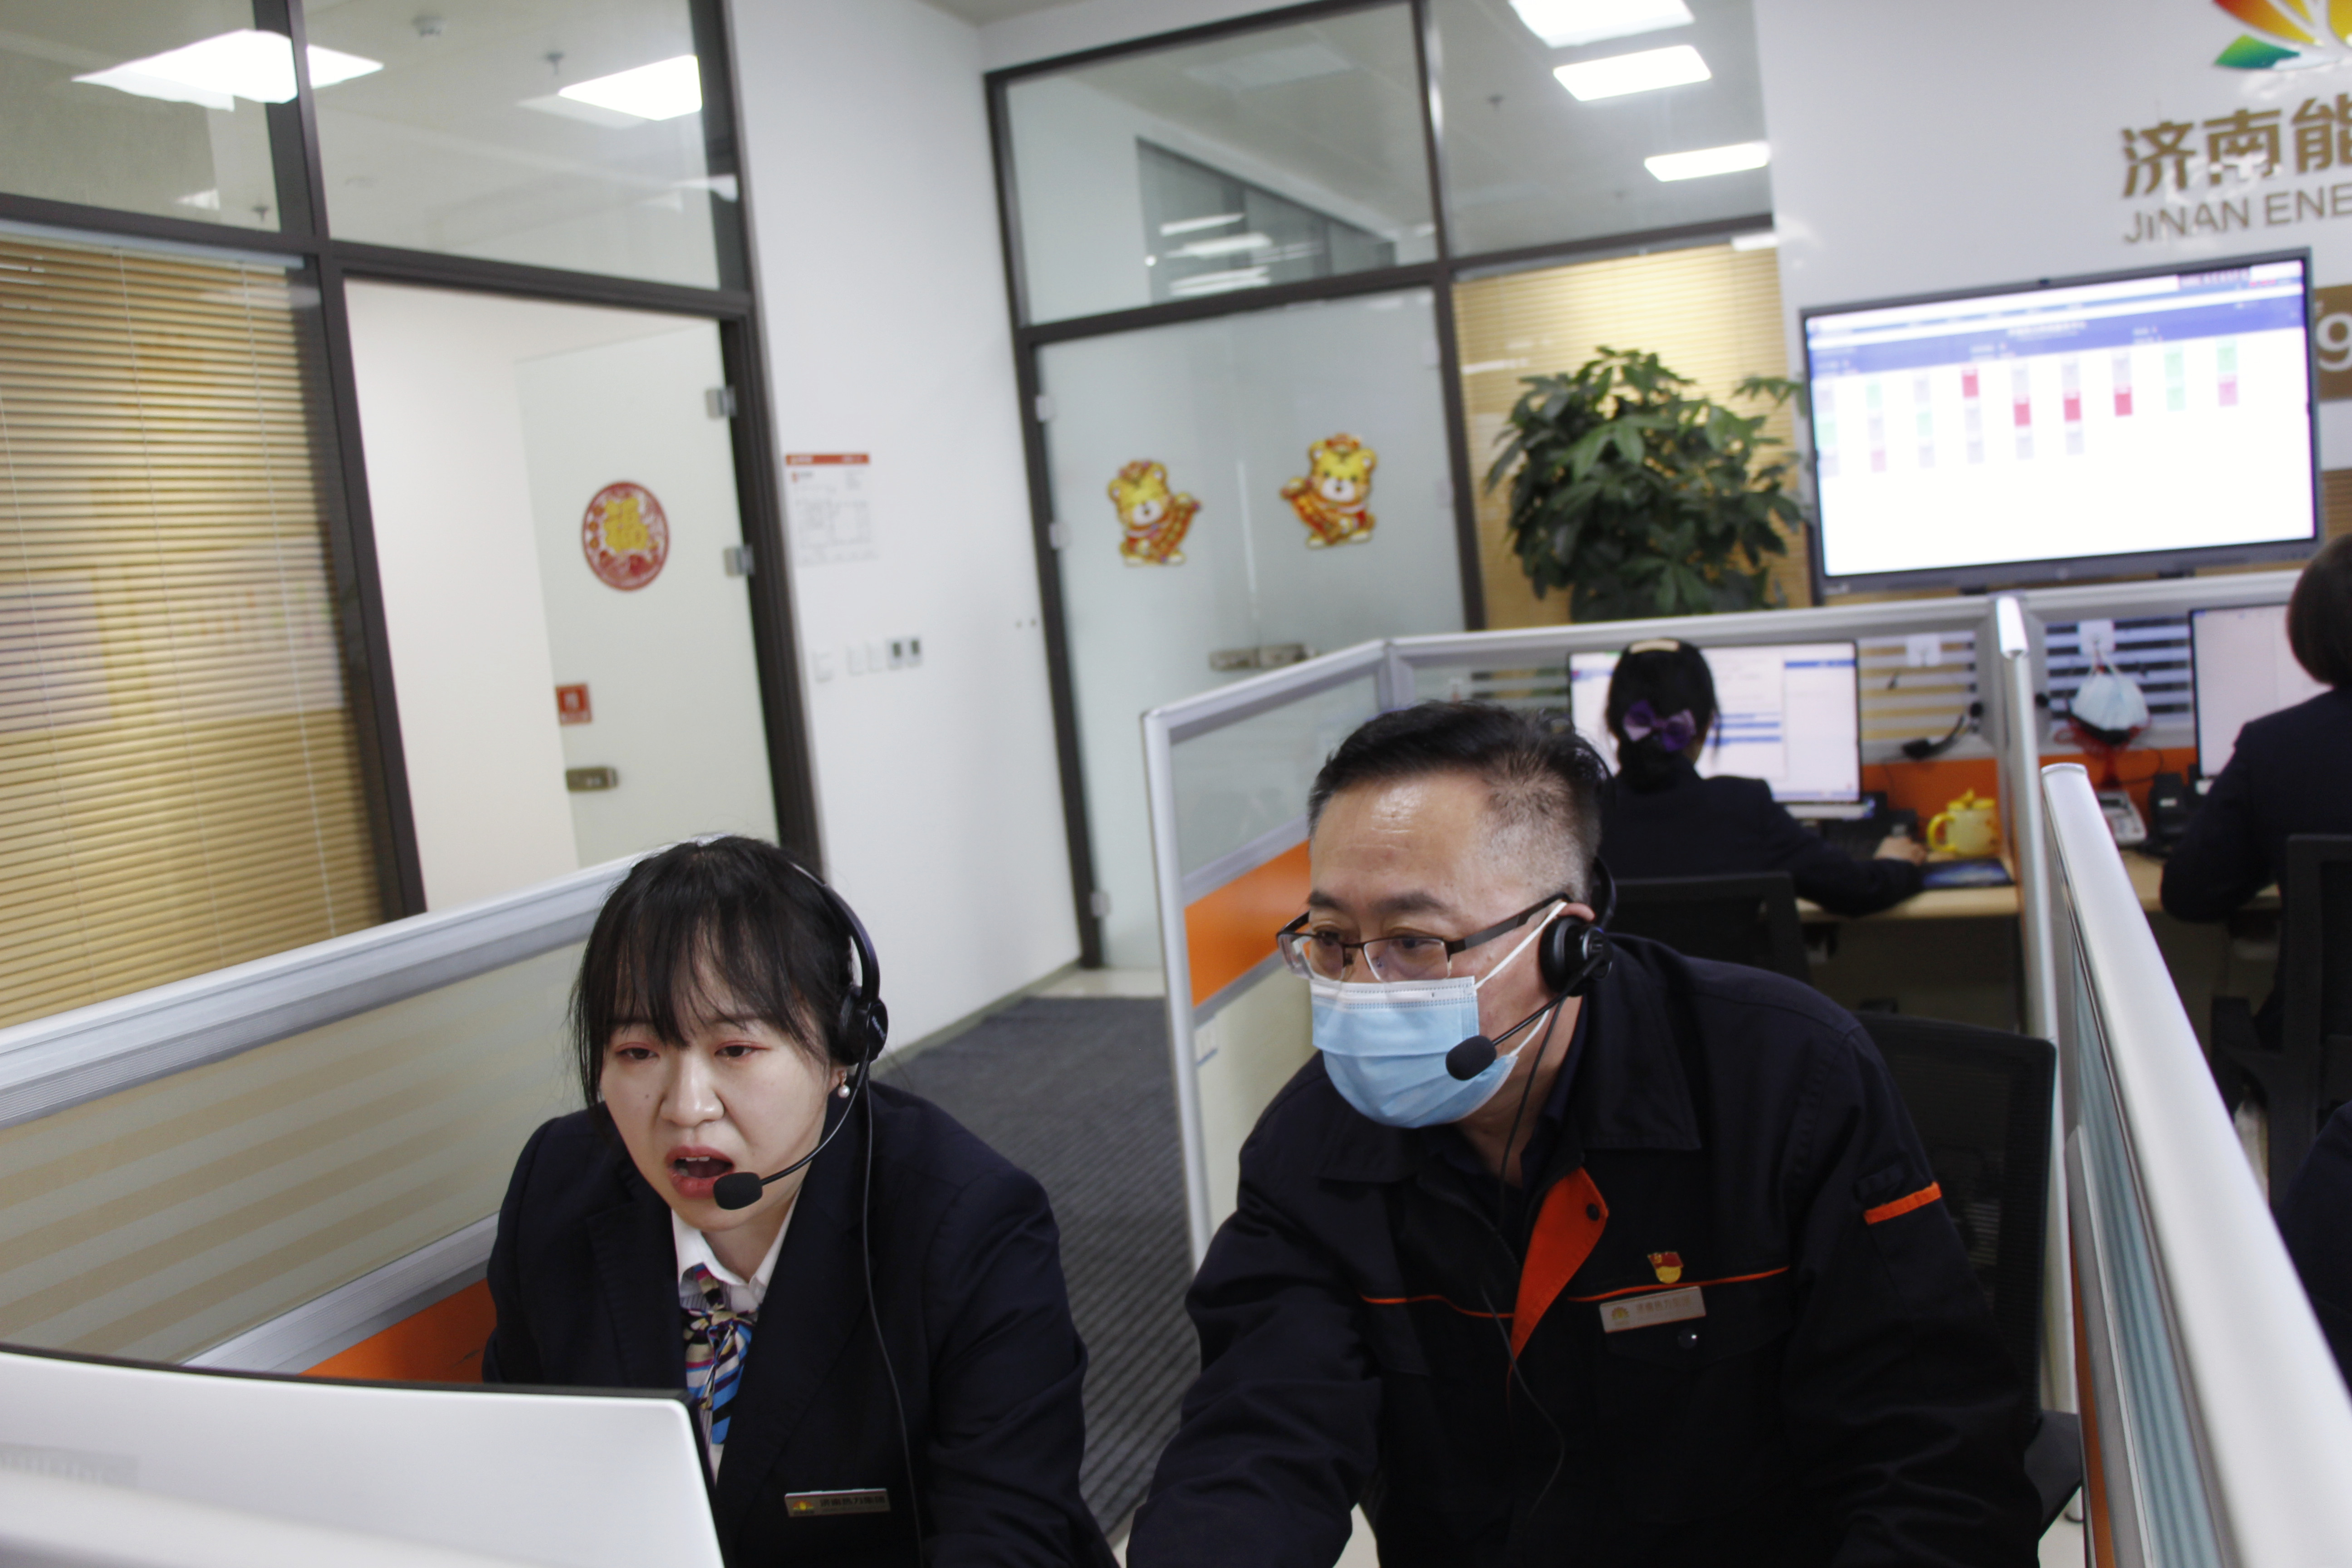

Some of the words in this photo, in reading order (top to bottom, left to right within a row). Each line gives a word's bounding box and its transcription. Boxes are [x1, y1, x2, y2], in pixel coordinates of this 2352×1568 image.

[2121, 93, 2352, 198] 济南能
[2123, 196, 2249, 243] JINAN
[2265, 182, 2352, 225] ENE
